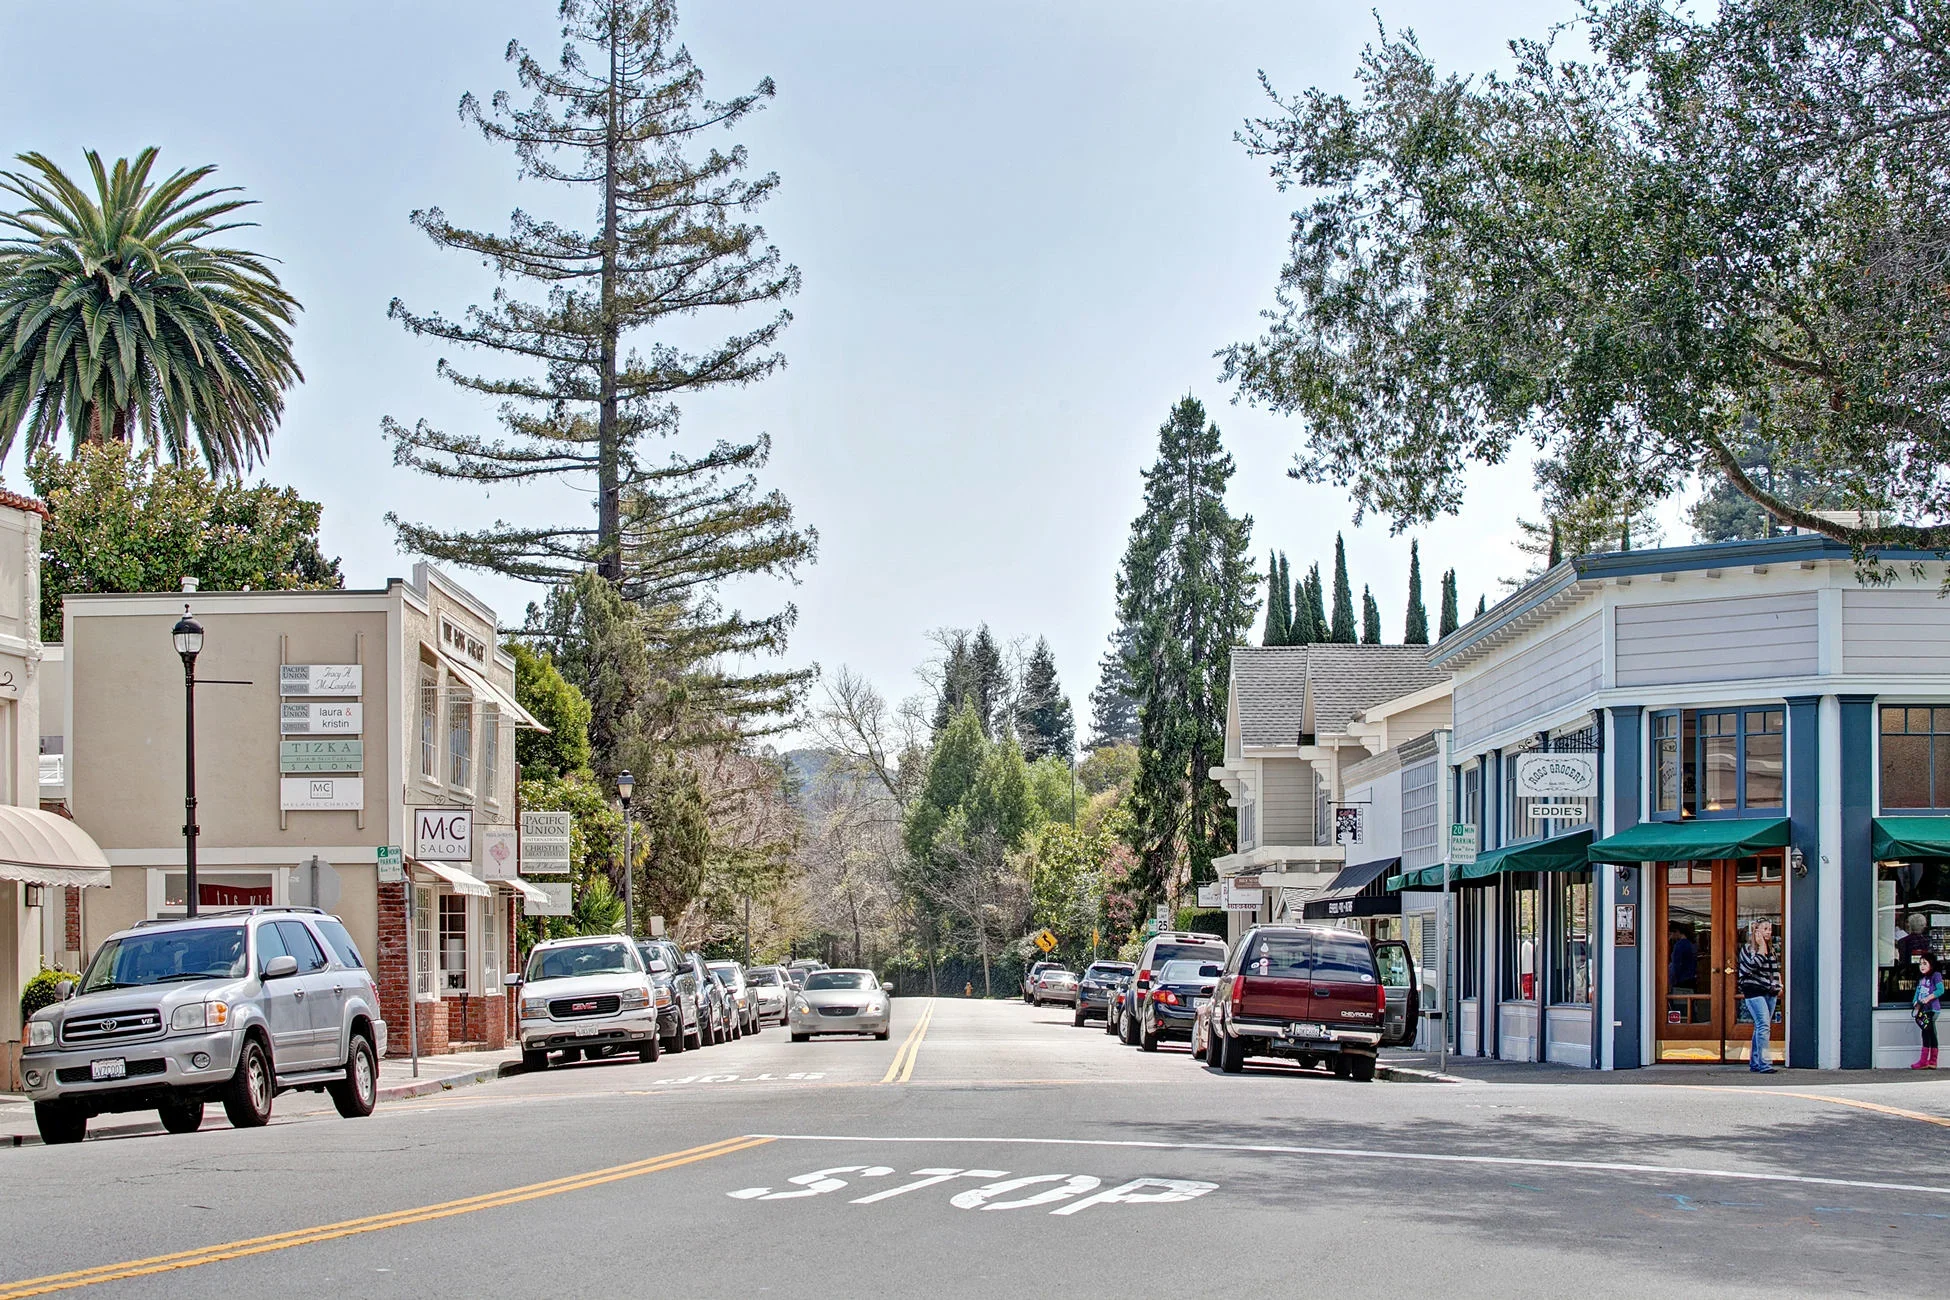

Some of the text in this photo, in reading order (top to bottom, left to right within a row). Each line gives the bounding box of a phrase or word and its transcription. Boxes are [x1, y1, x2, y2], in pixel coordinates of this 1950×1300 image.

[320, 708, 352, 716] laura &
[322, 720, 350, 728] kristin
[291, 743, 351, 753] TIZKA
[1528, 763, 1586, 785] ROSS GROCERY
[1532, 807, 1583, 816] EDDIE'S
[525, 816, 565, 825] PACIFIC
[525, 826, 565, 835] UNION
[1453, 825, 1463, 835] 20
[380, 848, 387, 856] 2
[420, 844, 467, 853] SALON
[1622, 885, 1630, 896] 16
[1158, 920, 1168, 931] 25
[571, 1001, 598, 1011] GMC
[1341, 1010, 1374, 1018] CHEVROLET
[141, 1017, 154, 1025] V8
[725, 1165, 1220, 1215] STOP
